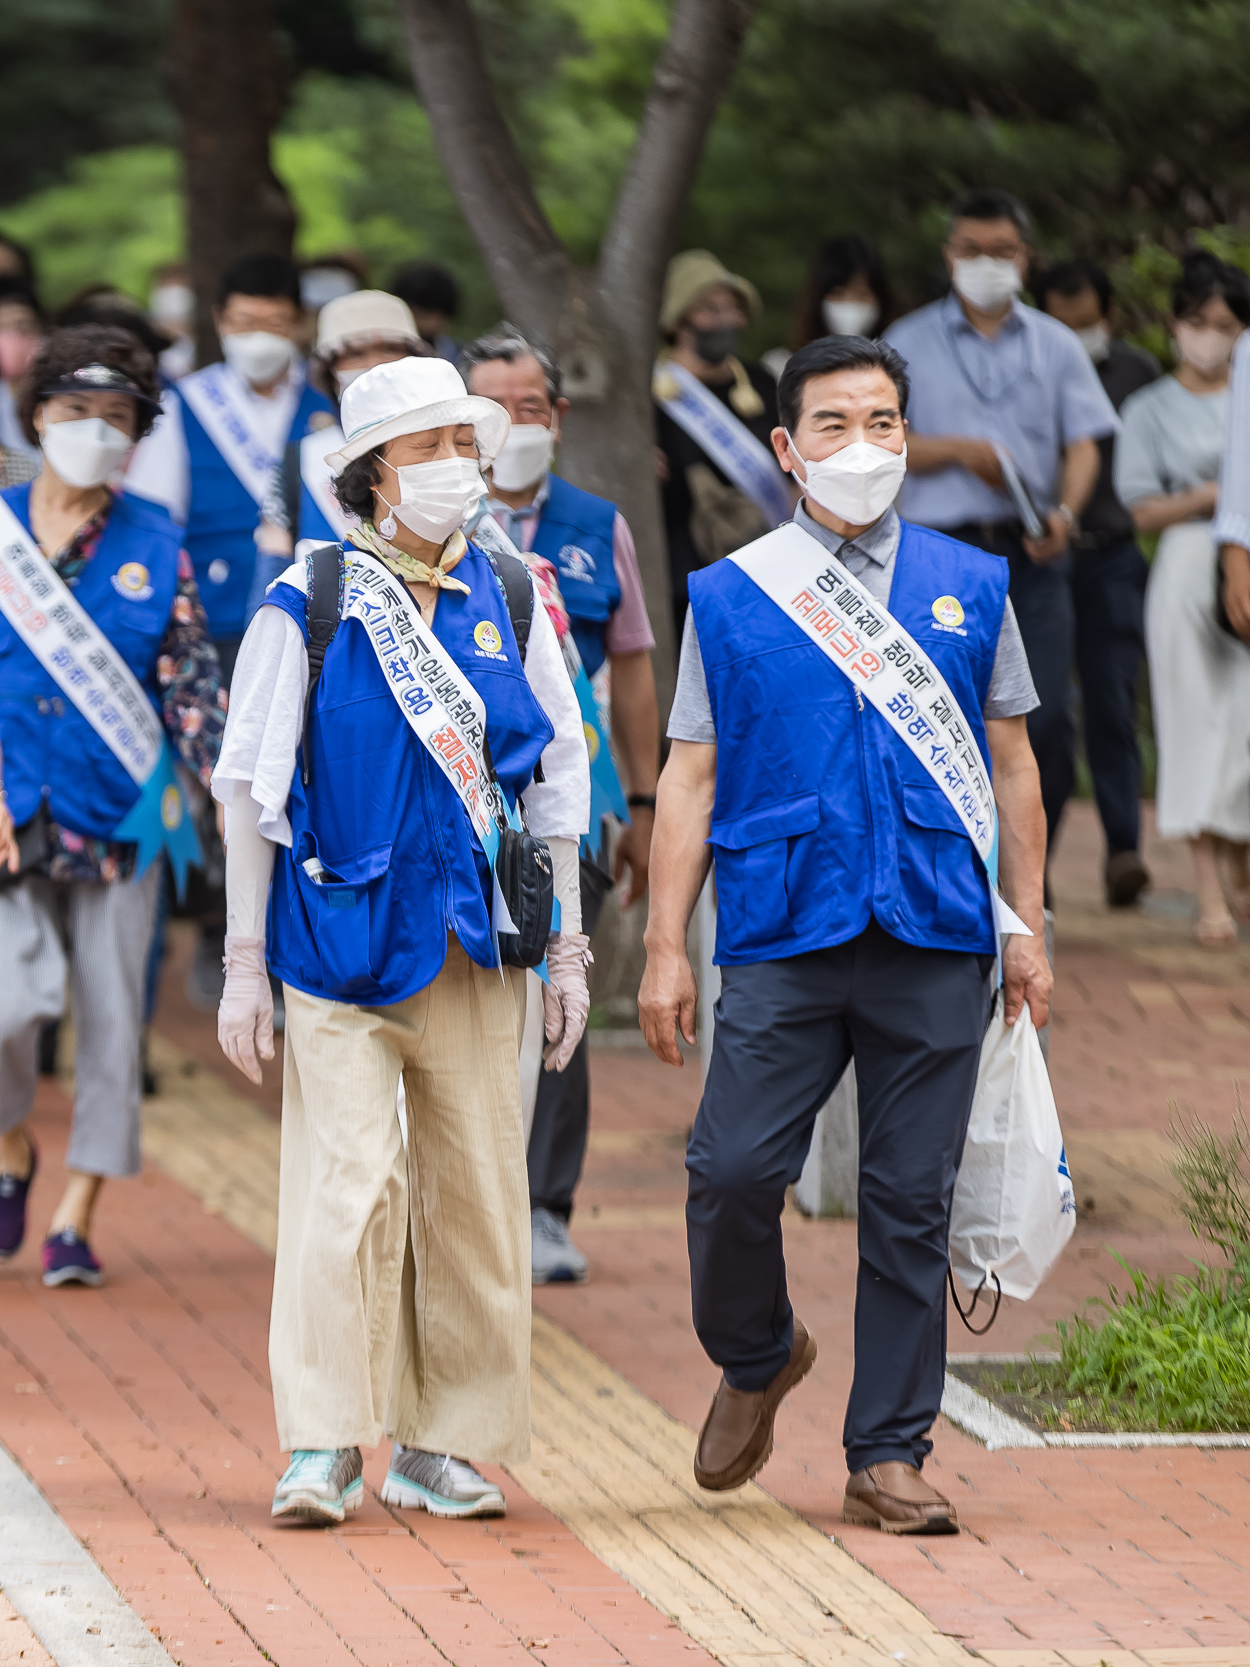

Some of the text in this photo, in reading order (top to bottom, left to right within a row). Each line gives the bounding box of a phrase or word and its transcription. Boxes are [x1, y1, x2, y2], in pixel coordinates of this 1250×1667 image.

[790, 589, 883, 680] 코로나19
[815, 568, 886, 640] 여름철
[881, 640, 935, 690] 행락
